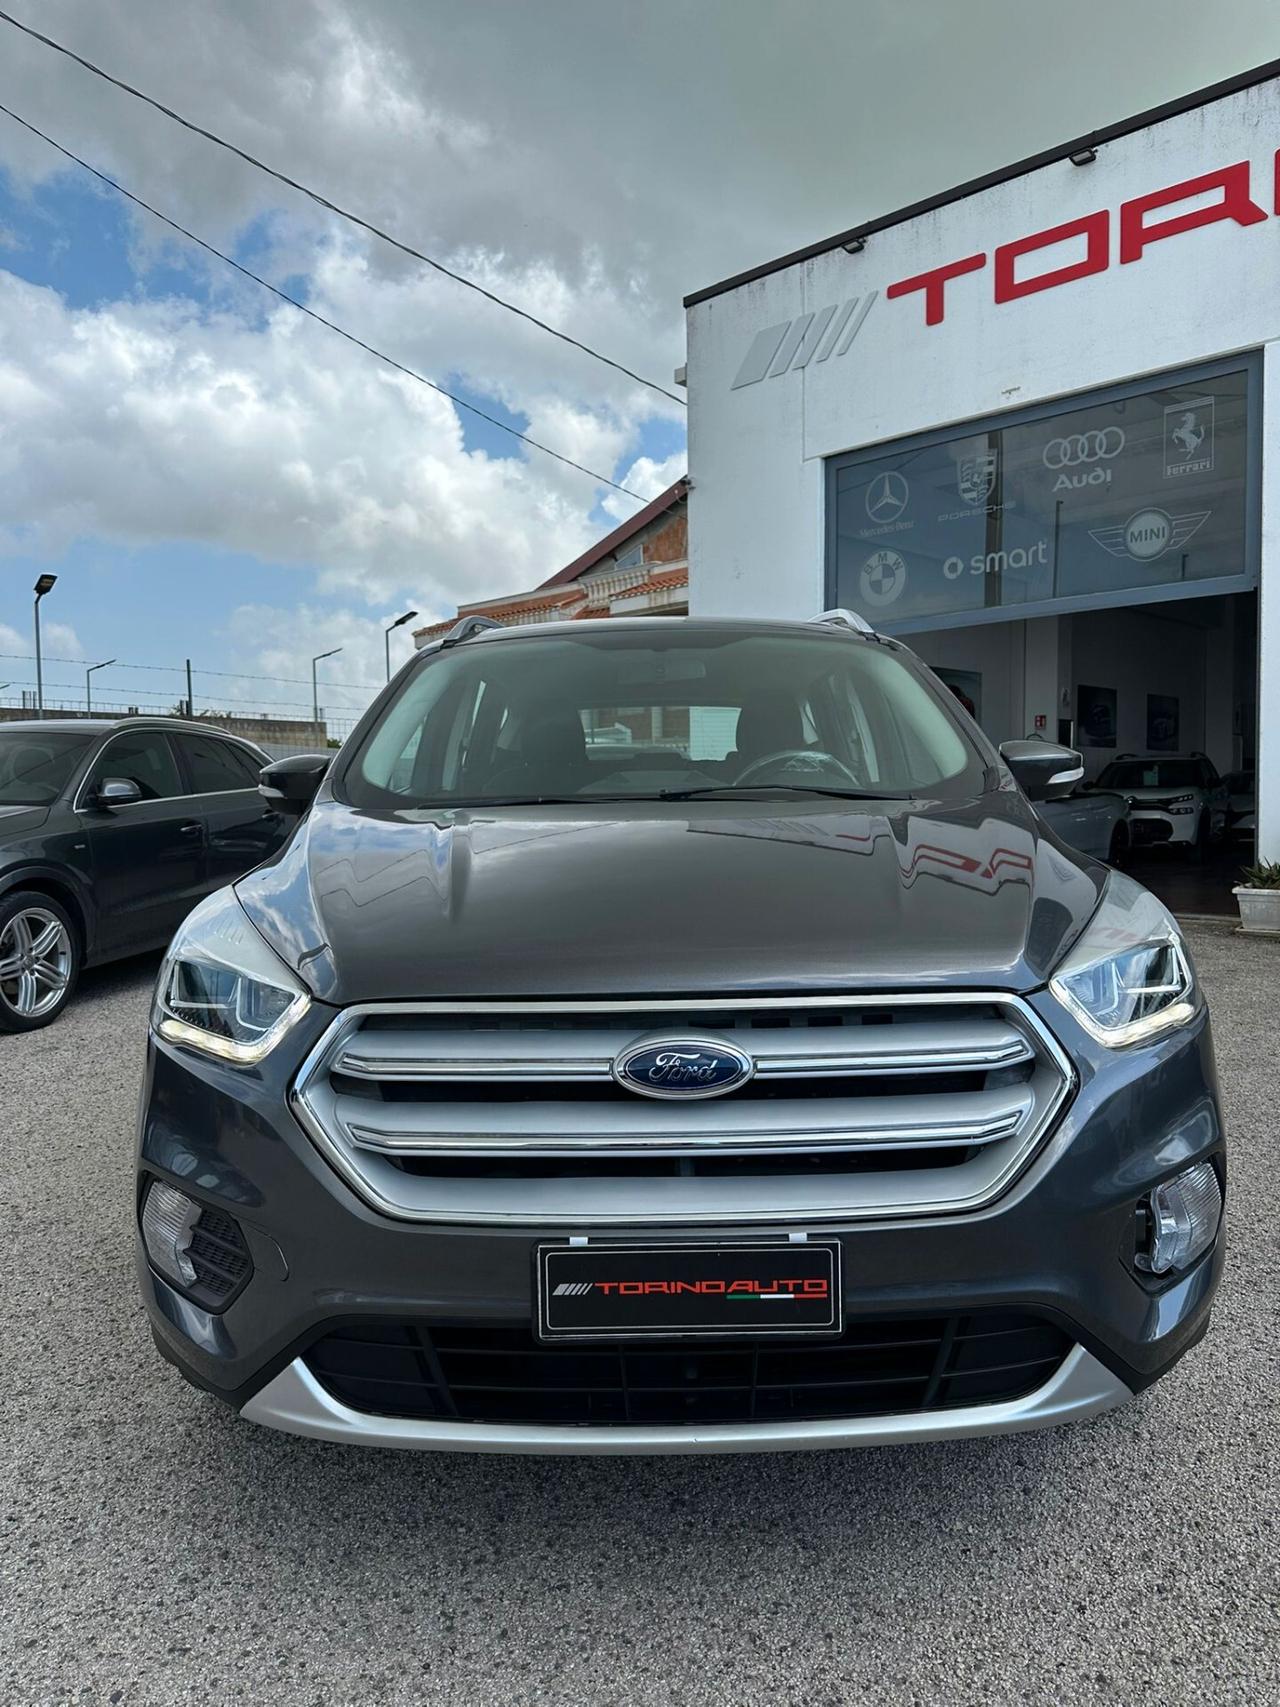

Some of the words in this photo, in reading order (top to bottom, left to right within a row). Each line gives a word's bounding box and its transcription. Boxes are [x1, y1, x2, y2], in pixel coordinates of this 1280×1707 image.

[1167, 460, 1211, 476] Ferrari
[1052, 467, 1112, 492] Audi
[938, 501, 1016, 521] PORSCHE
[1130, 526, 1166, 543] MINI
[863, 552, 904, 576] BMW
[970, 540, 1047, 575] smart
[649, 1052, 718, 1081] Ford
[594, 1279, 828, 1295] TORINOAUTO
